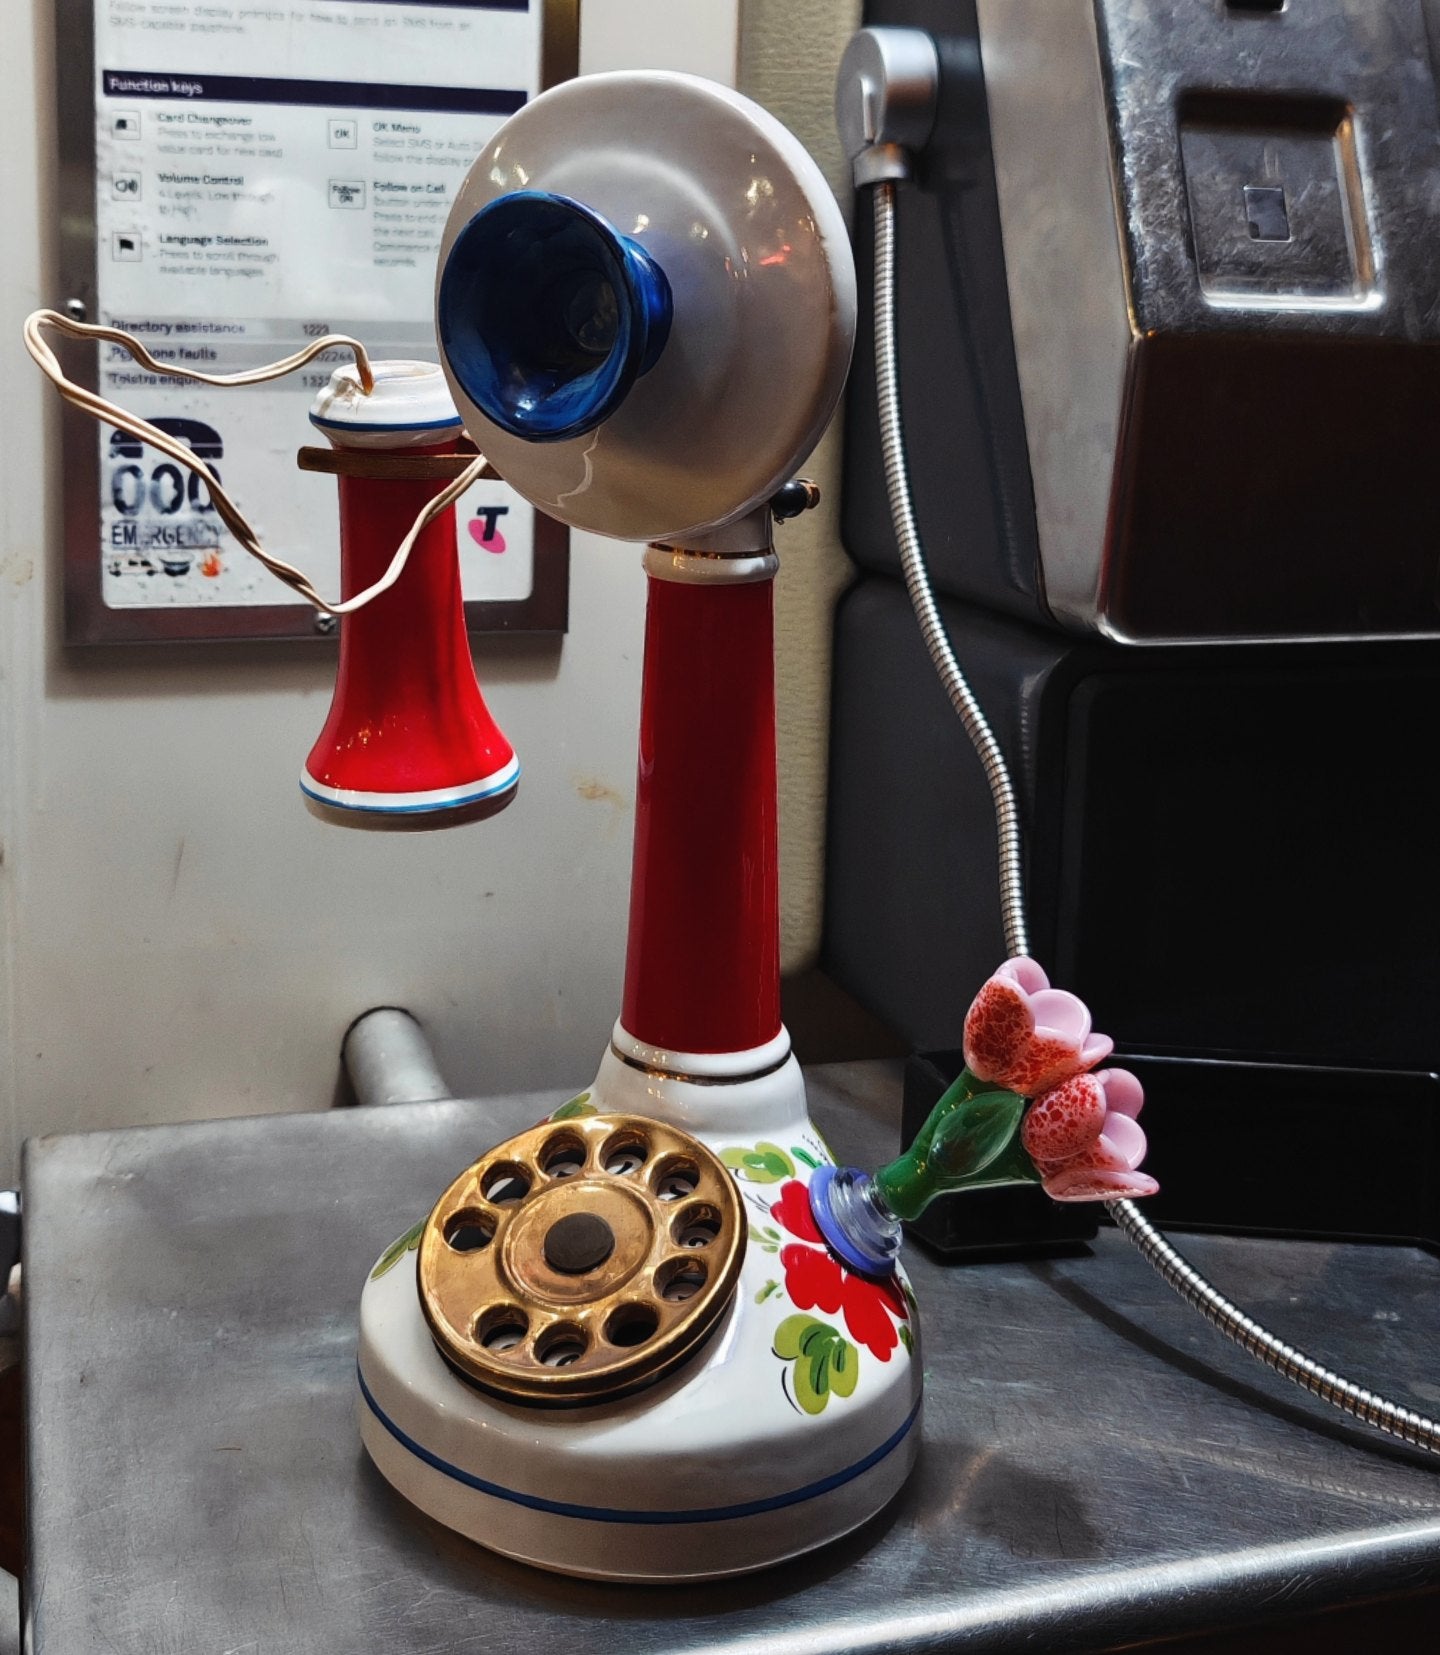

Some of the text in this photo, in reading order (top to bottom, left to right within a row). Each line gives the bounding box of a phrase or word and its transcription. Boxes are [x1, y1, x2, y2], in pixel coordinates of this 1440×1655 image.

[109, 77, 203, 97] Function keys
[157, 112, 253, 127] Card Changeover
[157, 173, 244, 186] Volume Control
[373, 181, 408, 193] Follow
[159, 232, 269, 247] Language Selection
[111, 320, 172, 336] Directory
[175, 320, 246, 335] assistance
[179, 346, 217, 360] faults
[110, 372, 157, 385] Telstra
[111, 463, 222, 517] 000
[477, 506, 509, 542] T
